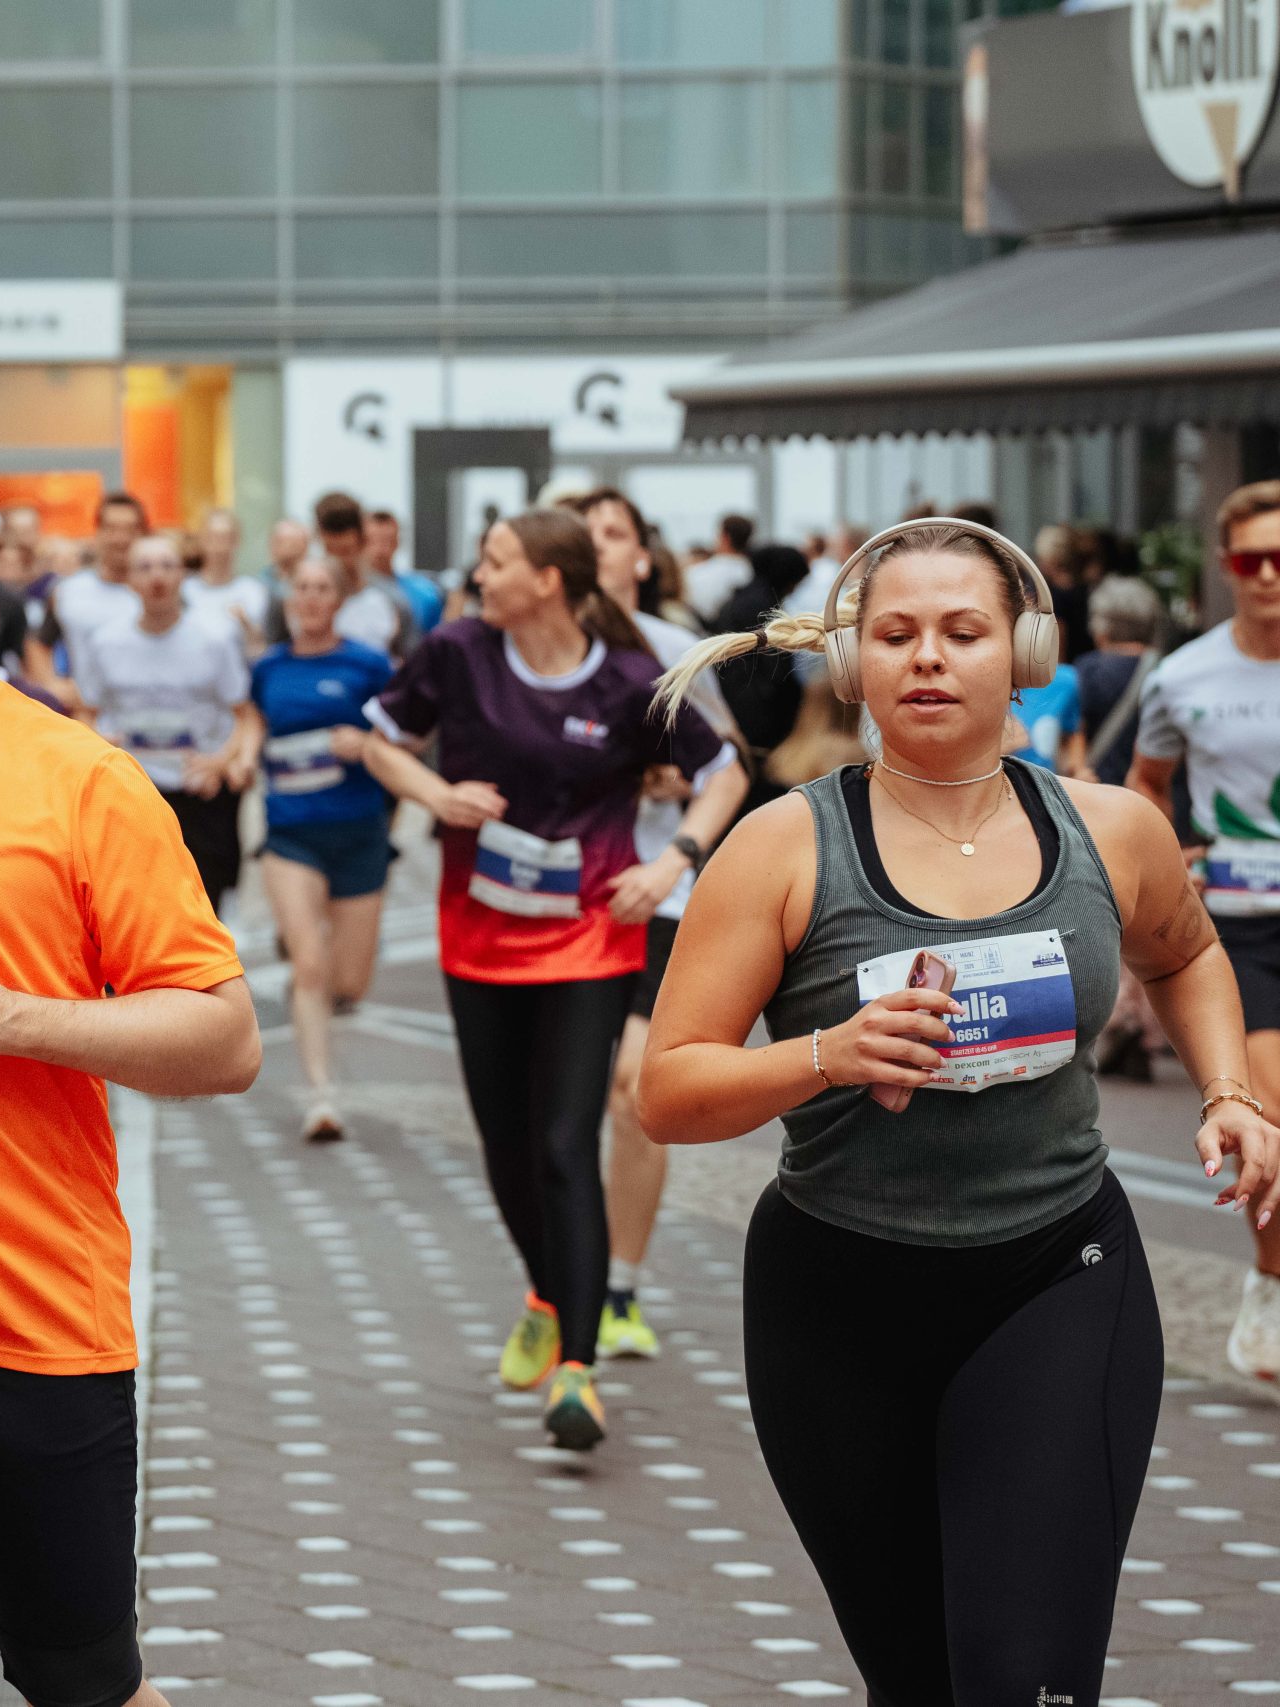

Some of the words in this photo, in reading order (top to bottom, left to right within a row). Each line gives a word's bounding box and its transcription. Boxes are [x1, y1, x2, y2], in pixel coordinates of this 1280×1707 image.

[1146, 0, 1262, 90] Knolli
[956, 1026, 989, 1043] 6651
[962, 1074, 976, 1082] dm
